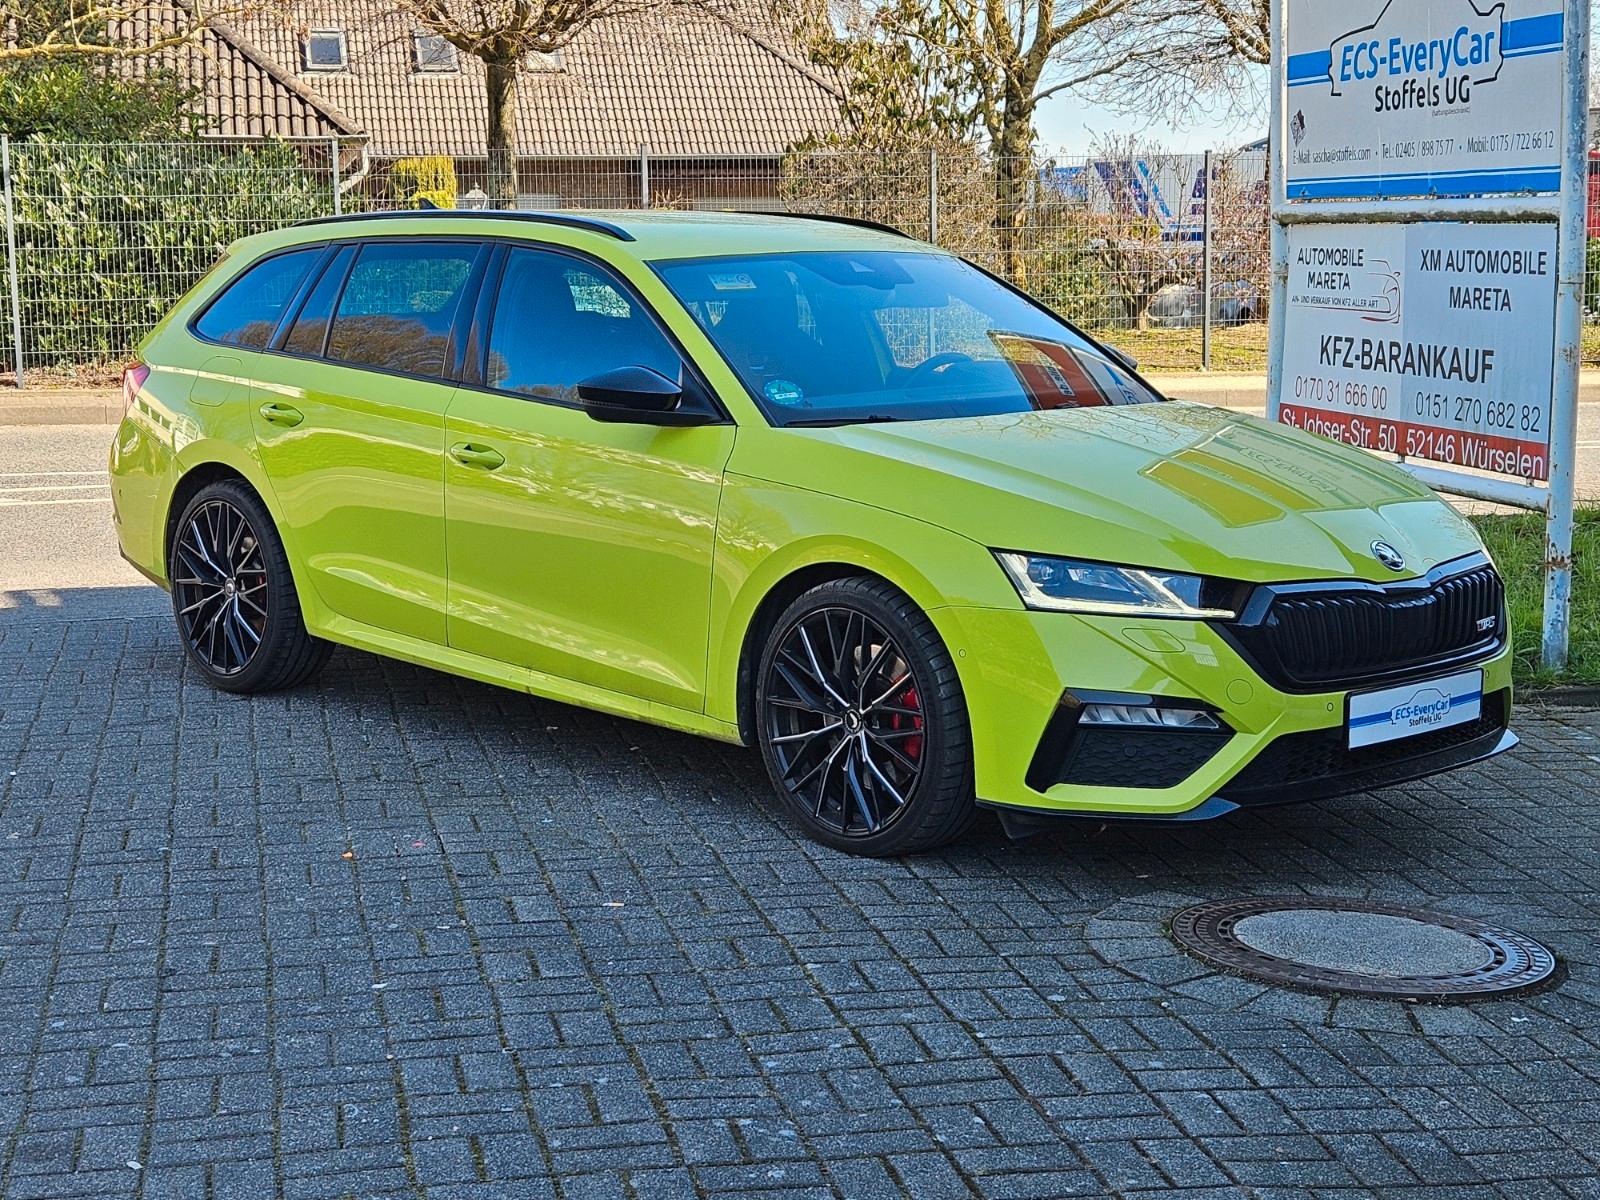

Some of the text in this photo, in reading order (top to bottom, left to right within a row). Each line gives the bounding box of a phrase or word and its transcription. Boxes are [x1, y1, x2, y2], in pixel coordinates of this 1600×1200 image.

[1340, 26, 1495, 82] ECS-EveryCar
[1375, 74, 1470, 112] Stoffels UG
[1312, 146, 1371, 164] sascha@stoffels.com
[1395, 141, 1415, 158] 02405
[1421, 140, 1434, 157] 898
[1435, 139, 1444, 156] 75
[1444, 138, 1454, 155] 77
[1467, 136, 1489, 153] Mobil:
[1490, 134, 1509, 152] 0175
[1515, 132, 1530, 150] 722
[1532, 131, 1542, 149] 66
[1544, 130, 1554, 148] 12
[1297, 247, 1364, 267] AUTOMOBILE
[1420, 248, 1547, 276] XM AUTOMOBILE
[1307, 271, 1351, 291] MARETA
[1301, 296, 1310, 304] UND
[1310, 296, 1331, 305] VERKAUF
[1331, 297, 1341, 306] VON
[1342, 298, 1351, 306] KFZ
[1352, 299, 1367, 307] ALLER
[1368, 300, 1378, 308] ART
[1449, 285, 1512, 312] MARETA
[1319, 334, 1494, 384] KFZ-BARANKAUF
[1295, 375, 1388, 410] 0170 31 666 00
[1415, 391, 1541, 433] 0151 270 682 82
[1378, 424, 1397, 452] 50
[1406, 428, 1456, 464] 52146
[1460, 436, 1544, 481] Würselen
[1395, 699, 1448, 720] ECS-EveryCar
[1409, 715, 1432, 727] Stoffels
[1433, 713, 1442, 721] UG
